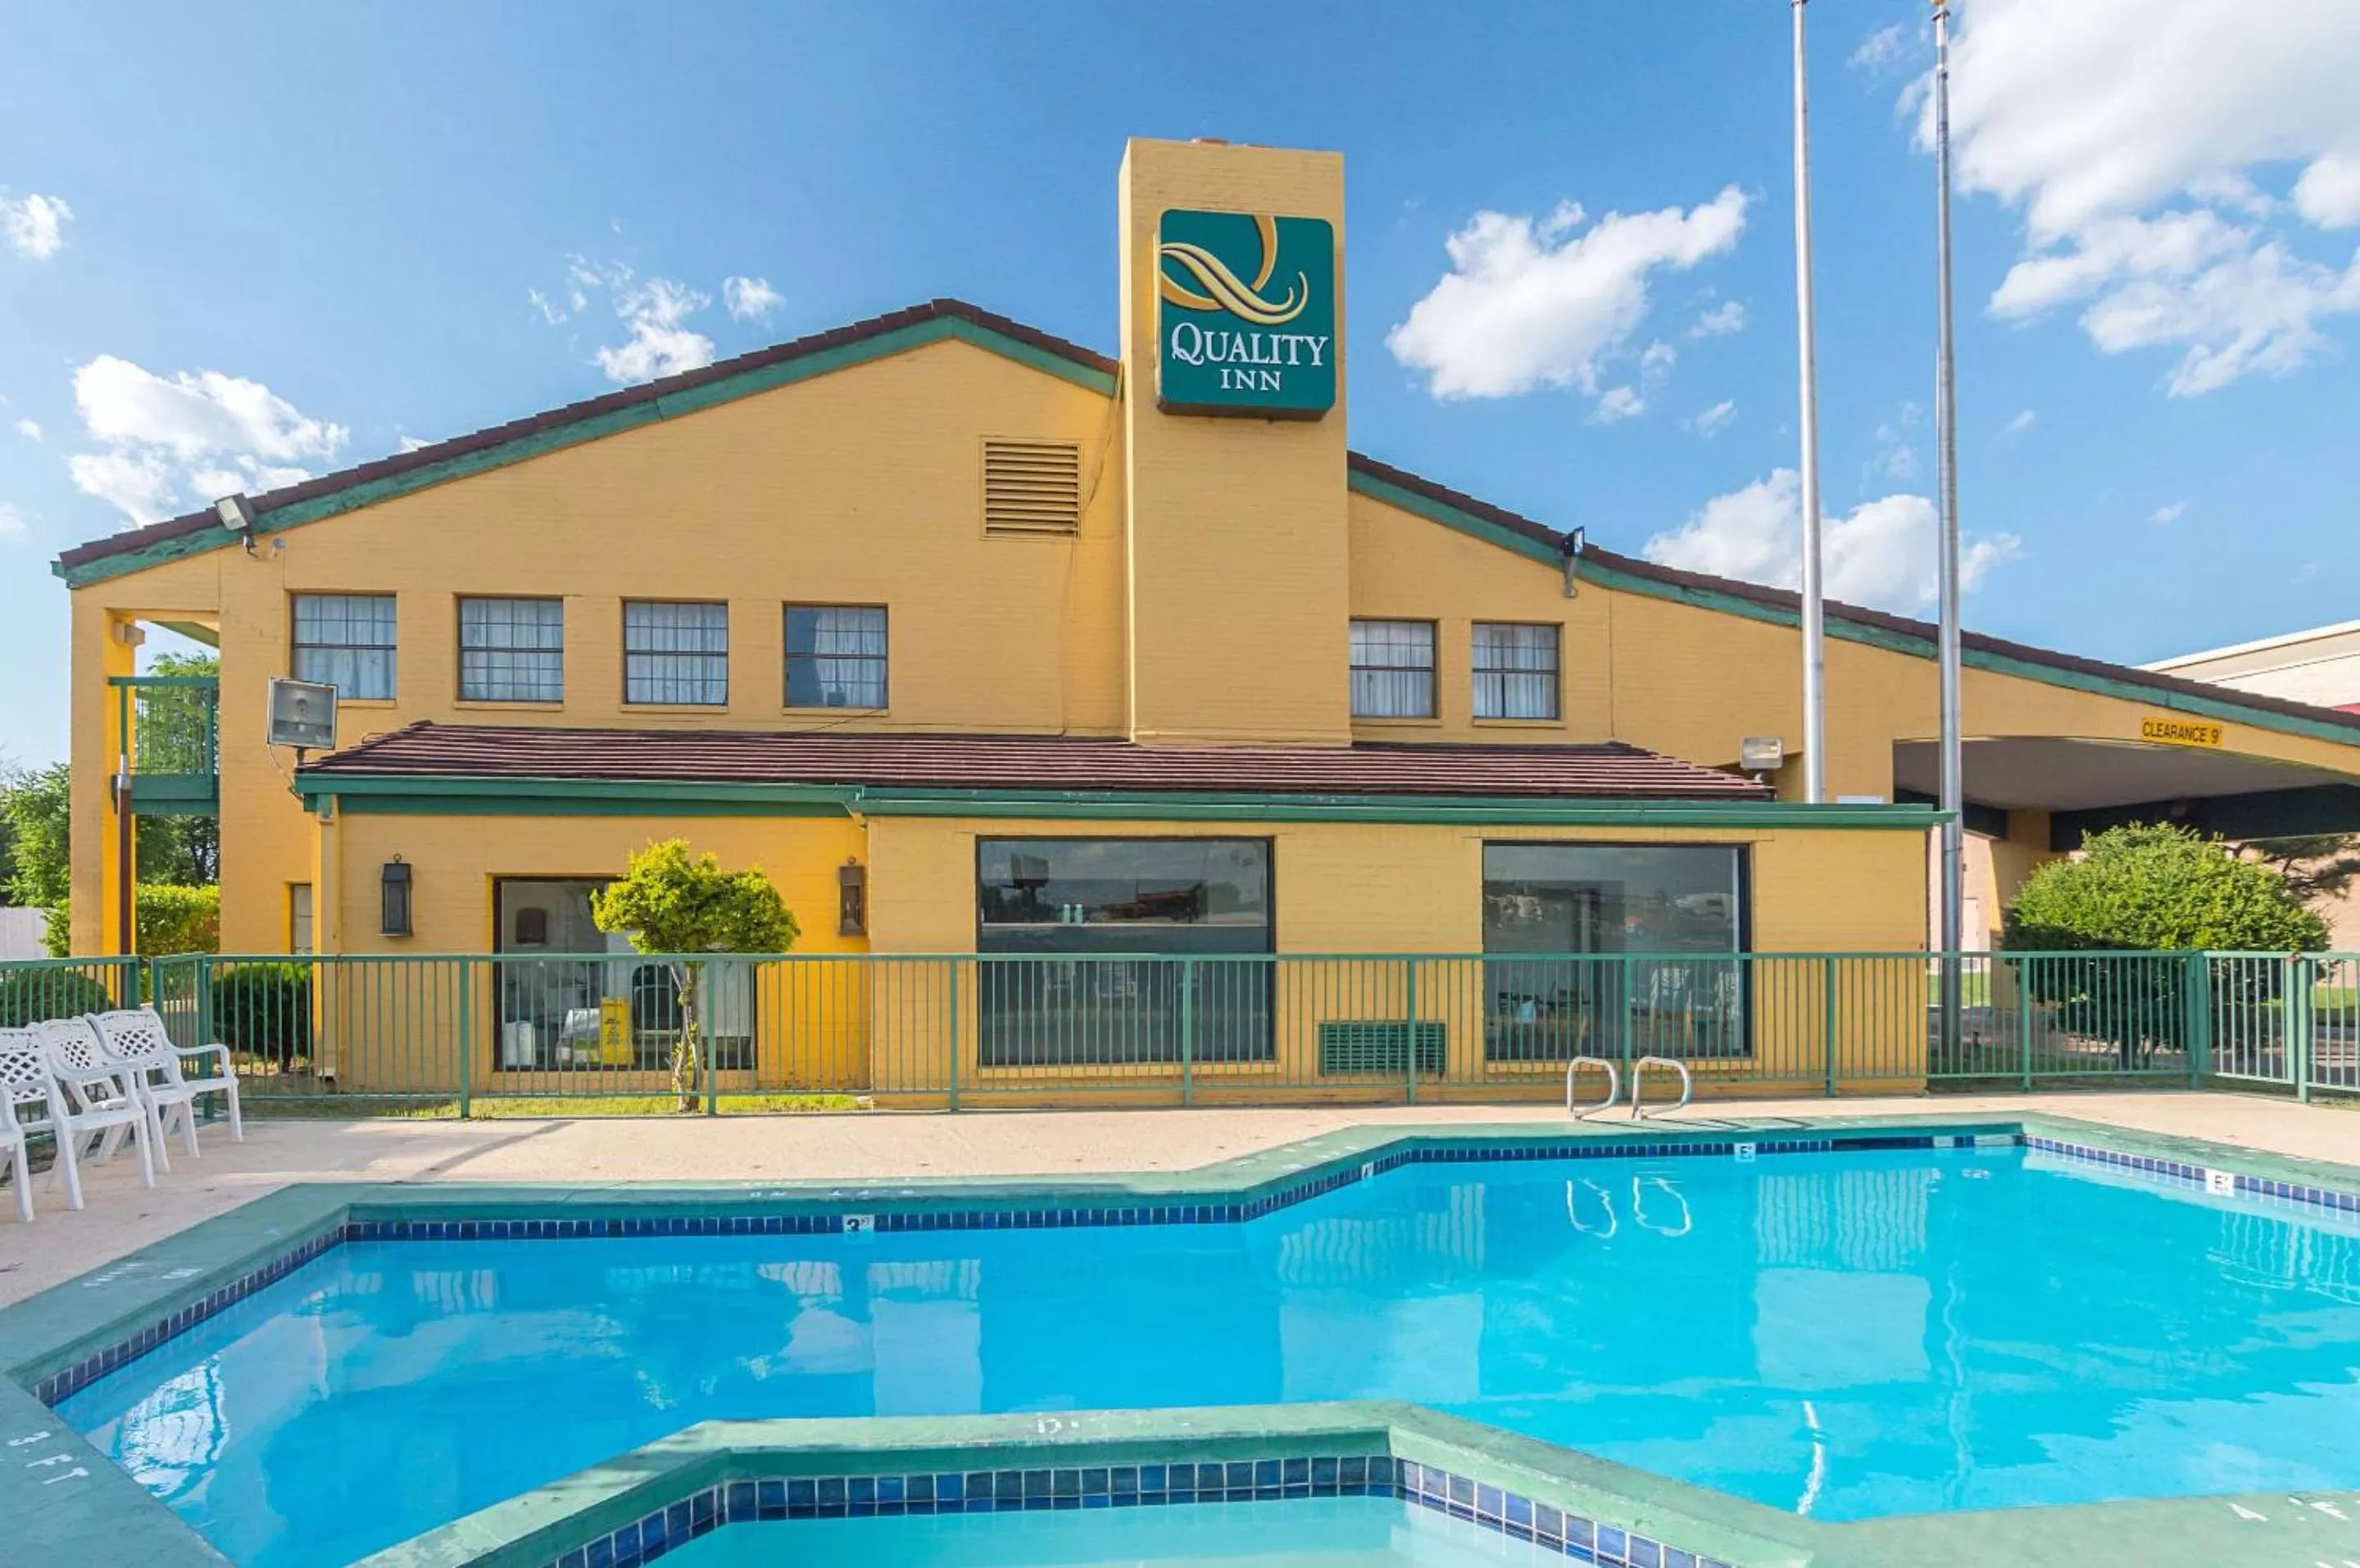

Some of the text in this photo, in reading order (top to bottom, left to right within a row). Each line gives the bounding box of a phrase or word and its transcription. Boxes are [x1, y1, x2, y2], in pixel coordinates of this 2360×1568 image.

[1171, 321, 1329, 366] QUALITY
[1220, 369, 1281, 391] INN
[2142, 721, 2206, 742] CLEARANCE
